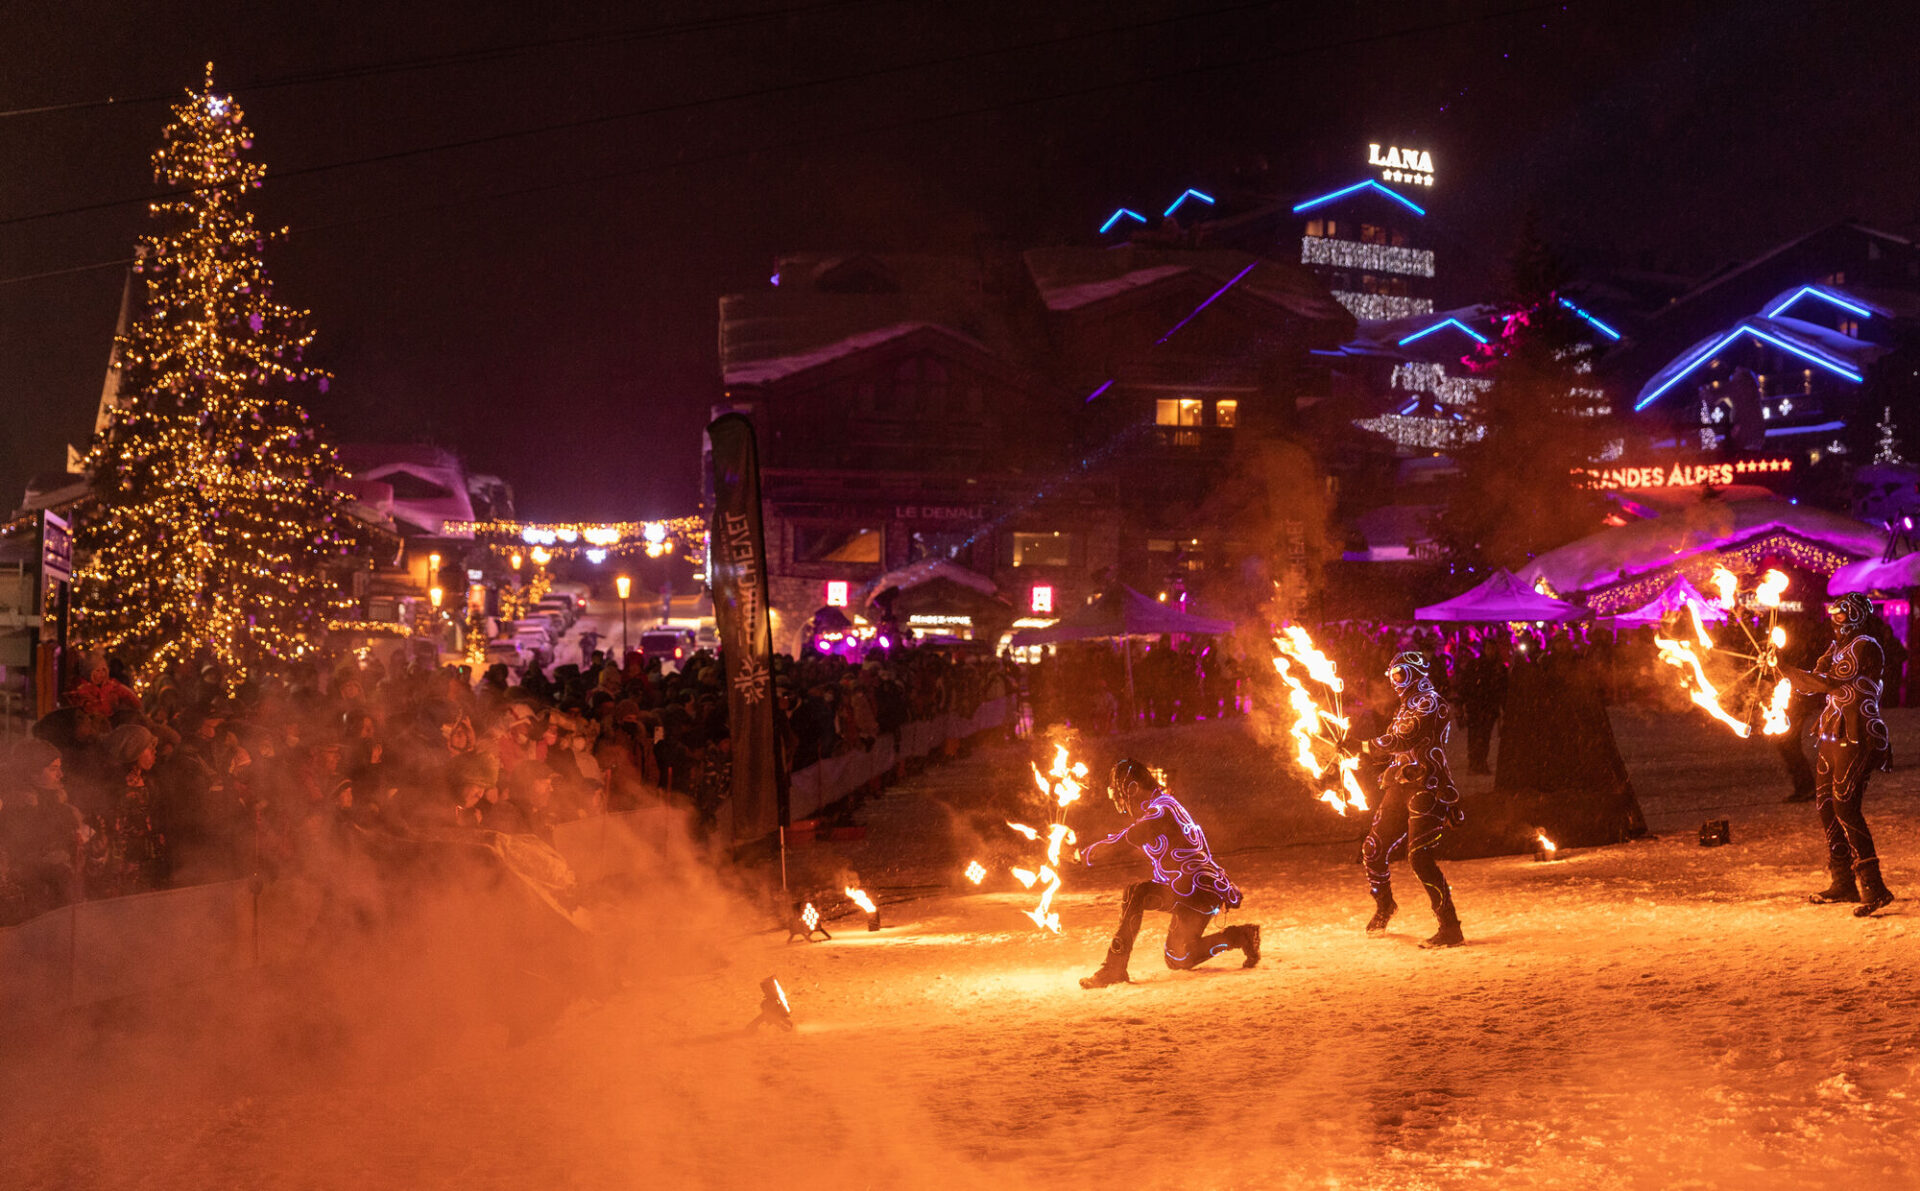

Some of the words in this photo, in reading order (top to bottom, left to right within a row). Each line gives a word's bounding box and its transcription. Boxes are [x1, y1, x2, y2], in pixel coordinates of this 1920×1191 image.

[1368, 143, 1434, 173] LANA
[1667, 462, 1734, 487] ALPES
[896, 506, 917, 518] LE
